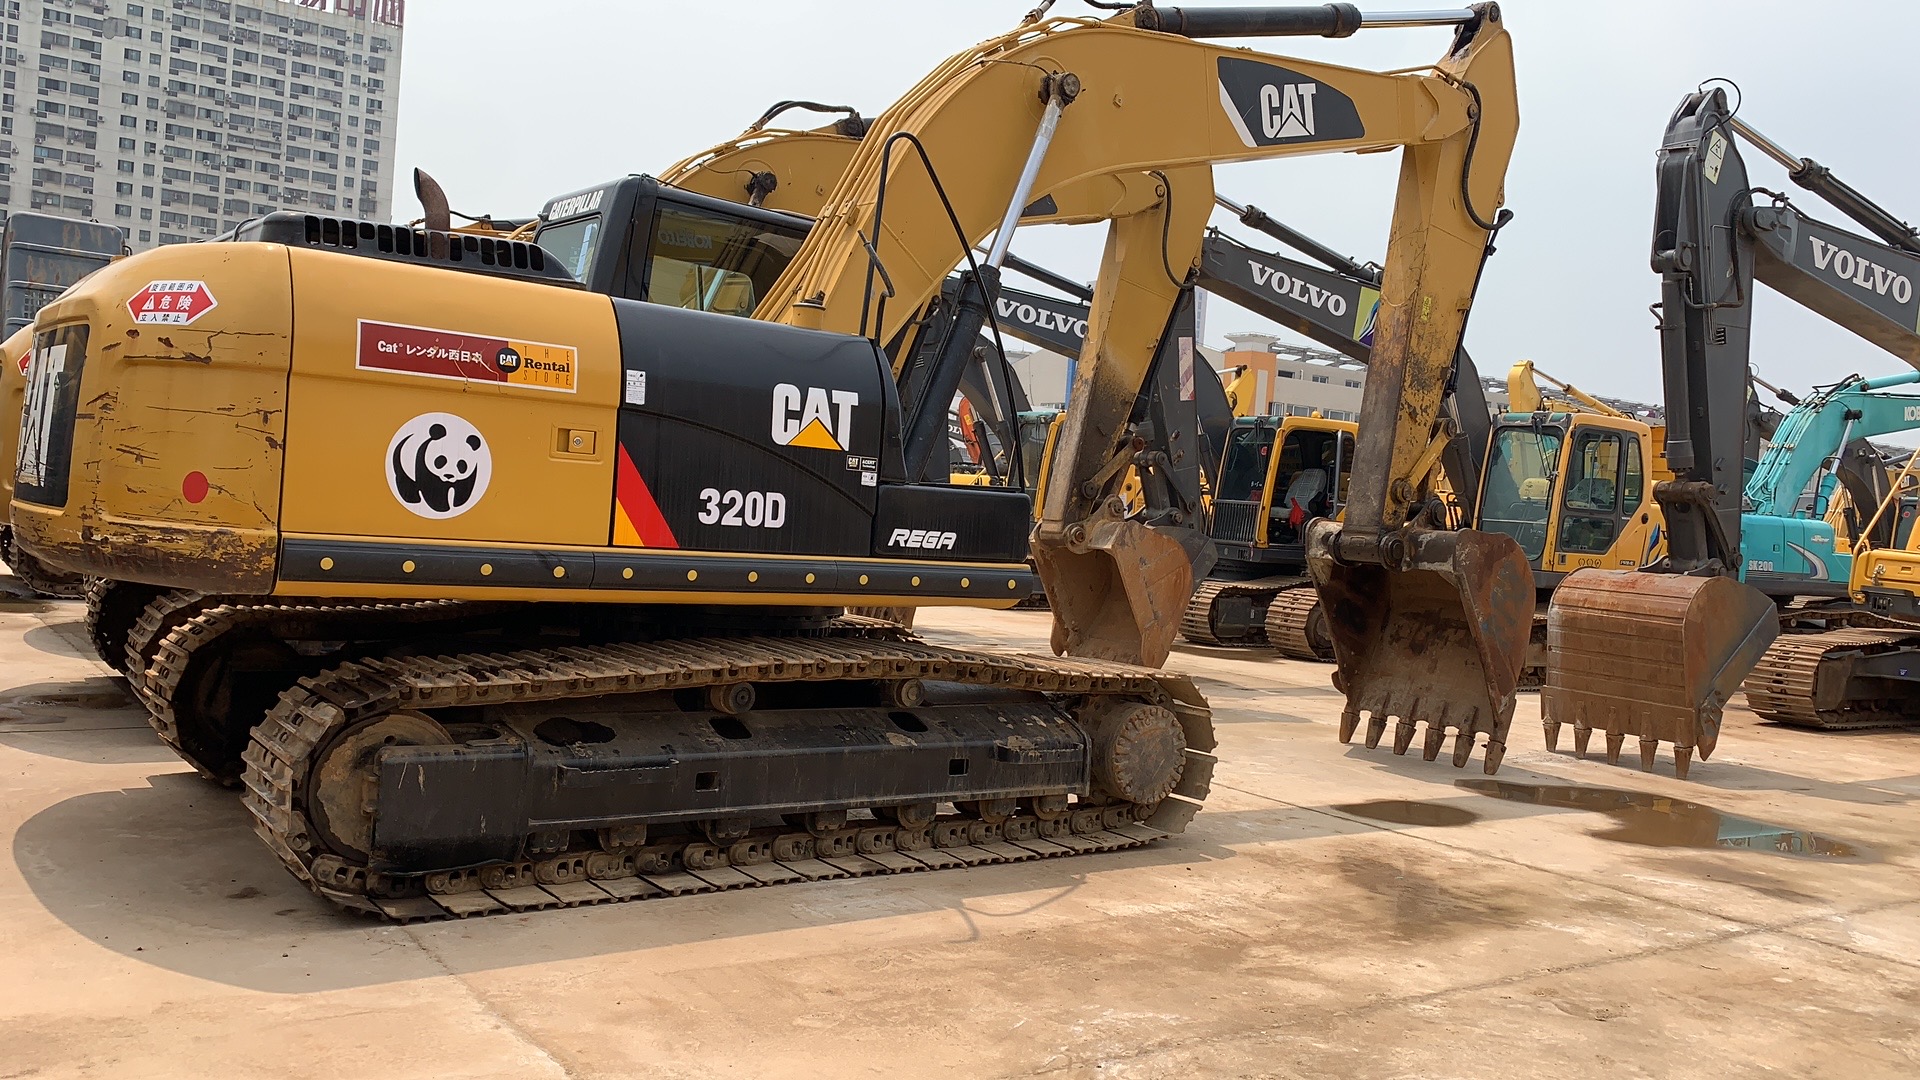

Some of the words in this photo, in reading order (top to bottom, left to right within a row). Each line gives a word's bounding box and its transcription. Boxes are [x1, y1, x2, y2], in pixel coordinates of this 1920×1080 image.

[1260, 83, 1316, 138] CAT
[548, 189, 604, 221] CATERPILLAR
[1809, 235, 1913, 304] VOLVO
[1248, 259, 1347, 317] VOLVO
[140, 313, 181, 323] 立入禁止
[499, 354, 518, 367] CAT
[523, 357, 571, 373] Rental
[771, 383, 859, 452] CAT
[698, 487, 786, 528] 320D
[887, 528, 957, 550] REGA
